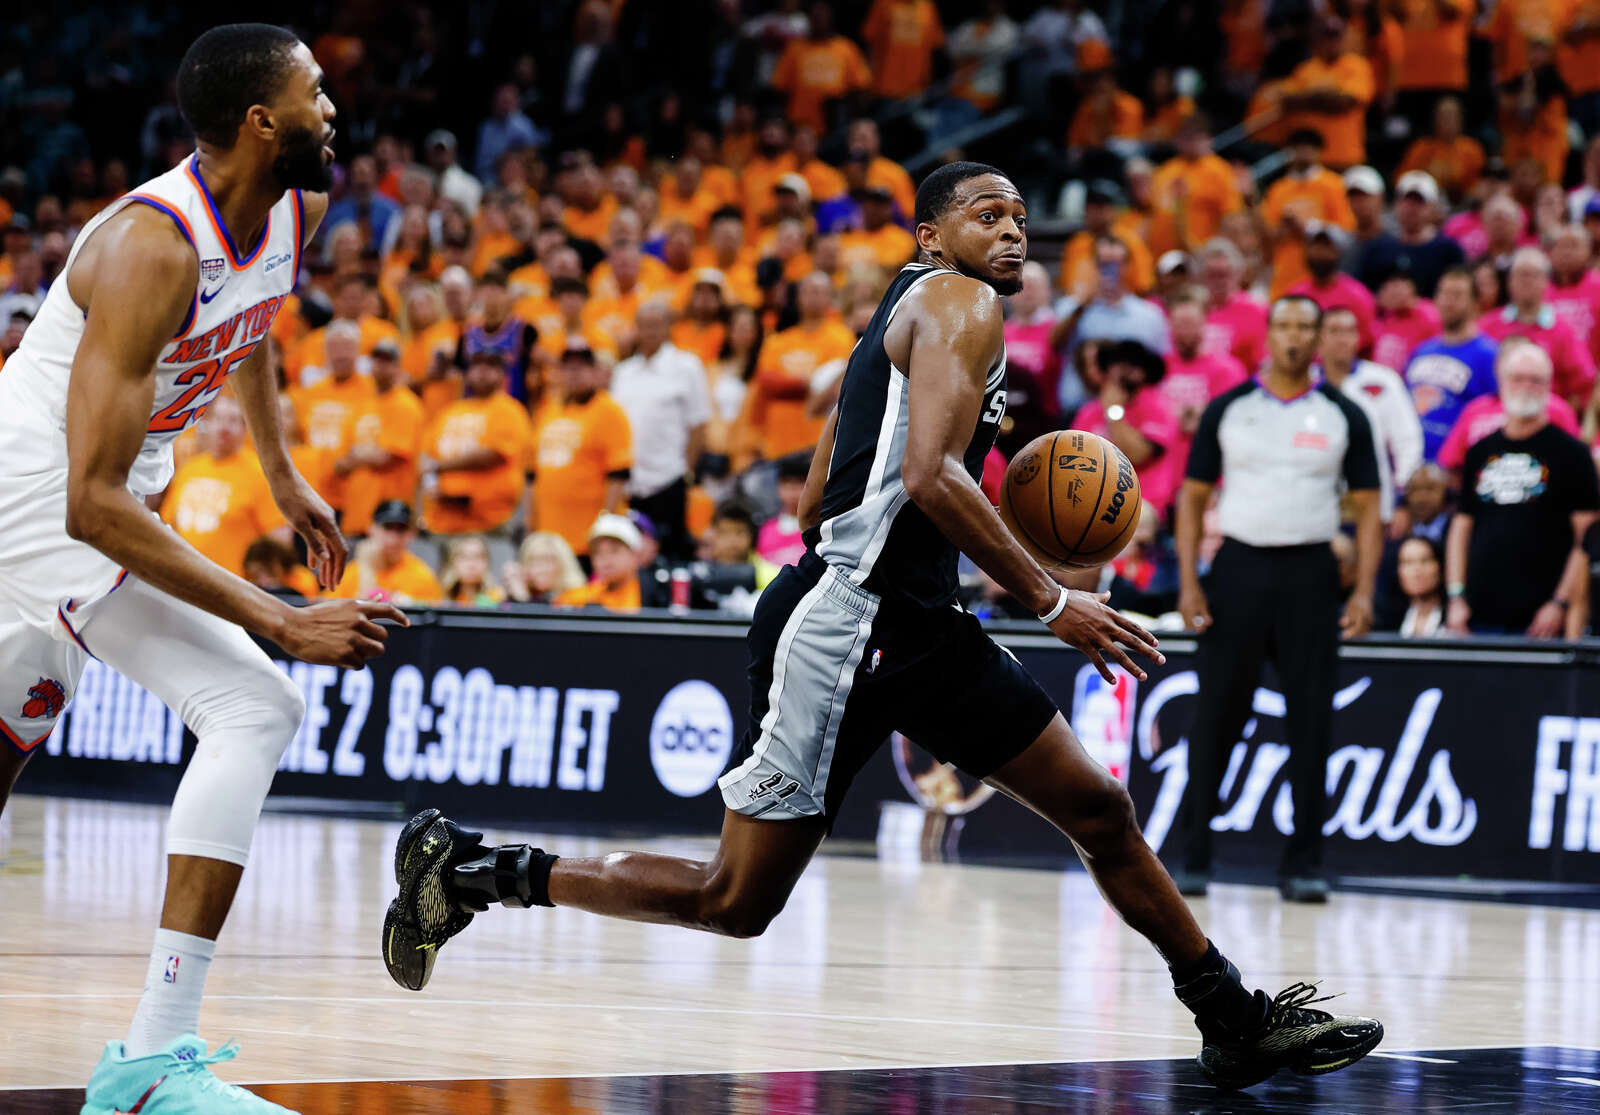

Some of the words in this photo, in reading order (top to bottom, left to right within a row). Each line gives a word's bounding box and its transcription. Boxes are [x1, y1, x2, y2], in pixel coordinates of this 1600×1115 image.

[161, 312, 244, 363] NEW
[146, 340, 262, 433] 25
[332, 664, 375, 777] 2
[383, 664, 560, 788] 8:30PM
[556, 687, 620, 792] ET
[661, 714, 723, 752] abc
